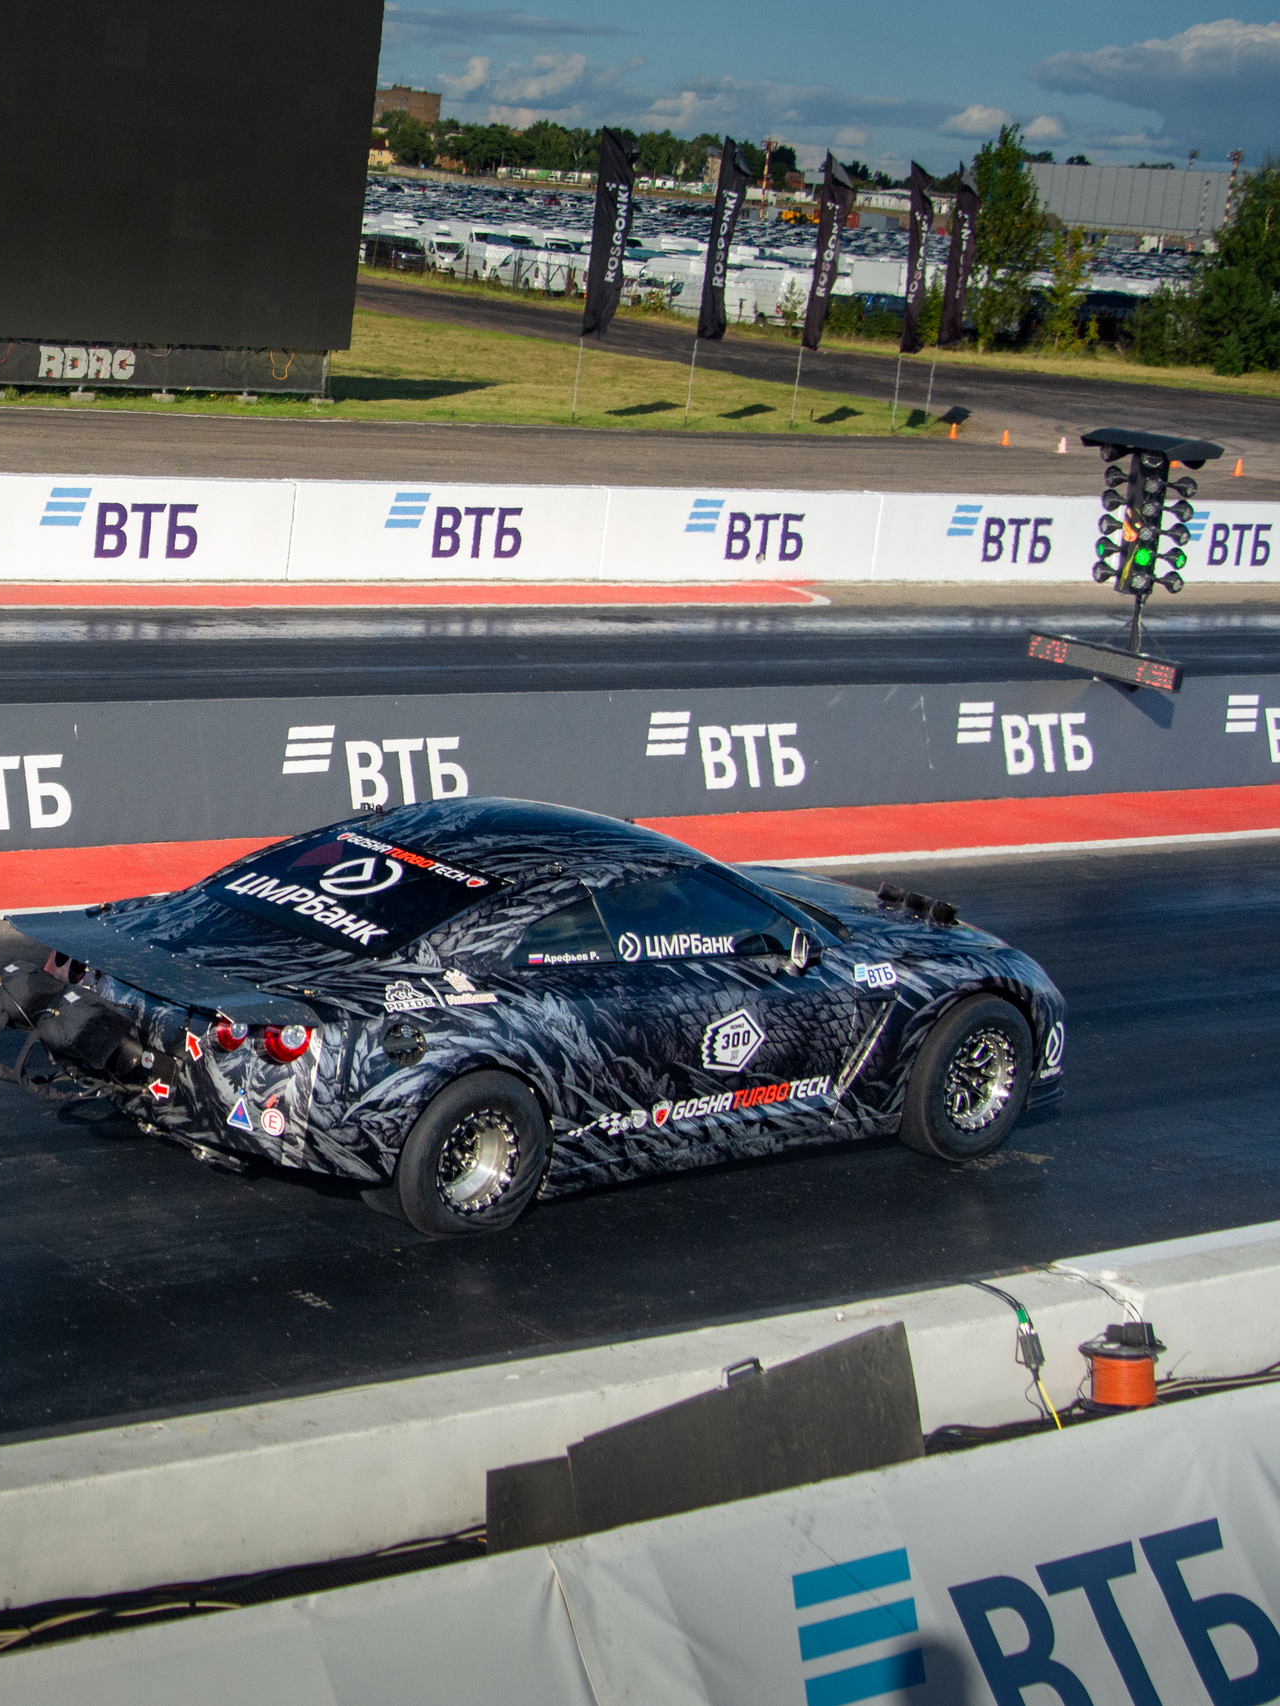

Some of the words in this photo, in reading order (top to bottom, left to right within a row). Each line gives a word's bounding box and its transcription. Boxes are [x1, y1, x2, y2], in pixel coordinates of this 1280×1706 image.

[604, 183, 629, 283] ROSGONKI
[38, 345, 136, 379] RDRC
[94, 502, 199, 559] ВТБ
[431, 506, 523, 559] ВТБ
[724, 512, 806, 562] ВТБ
[980, 517, 1053, 563] ВТБ
[1207, 523, 1273, 567] ВТБ
[698, 723, 806, 790] ВТБ
[1001, 712, 1094, 776] ВТБ
[345, 736, 469, 810] ВТБ
[225, 872, 389, 946] ЦМРБанк
[645, 934, 735, 957] ЦМРБанк
[867, 965, 894, 984] ВТБ
[385, 998, 433, 1012] PRIDE
[721, 1030, 751, 1050] 300
[947, 1517, 1280, 1706] ВТБ
